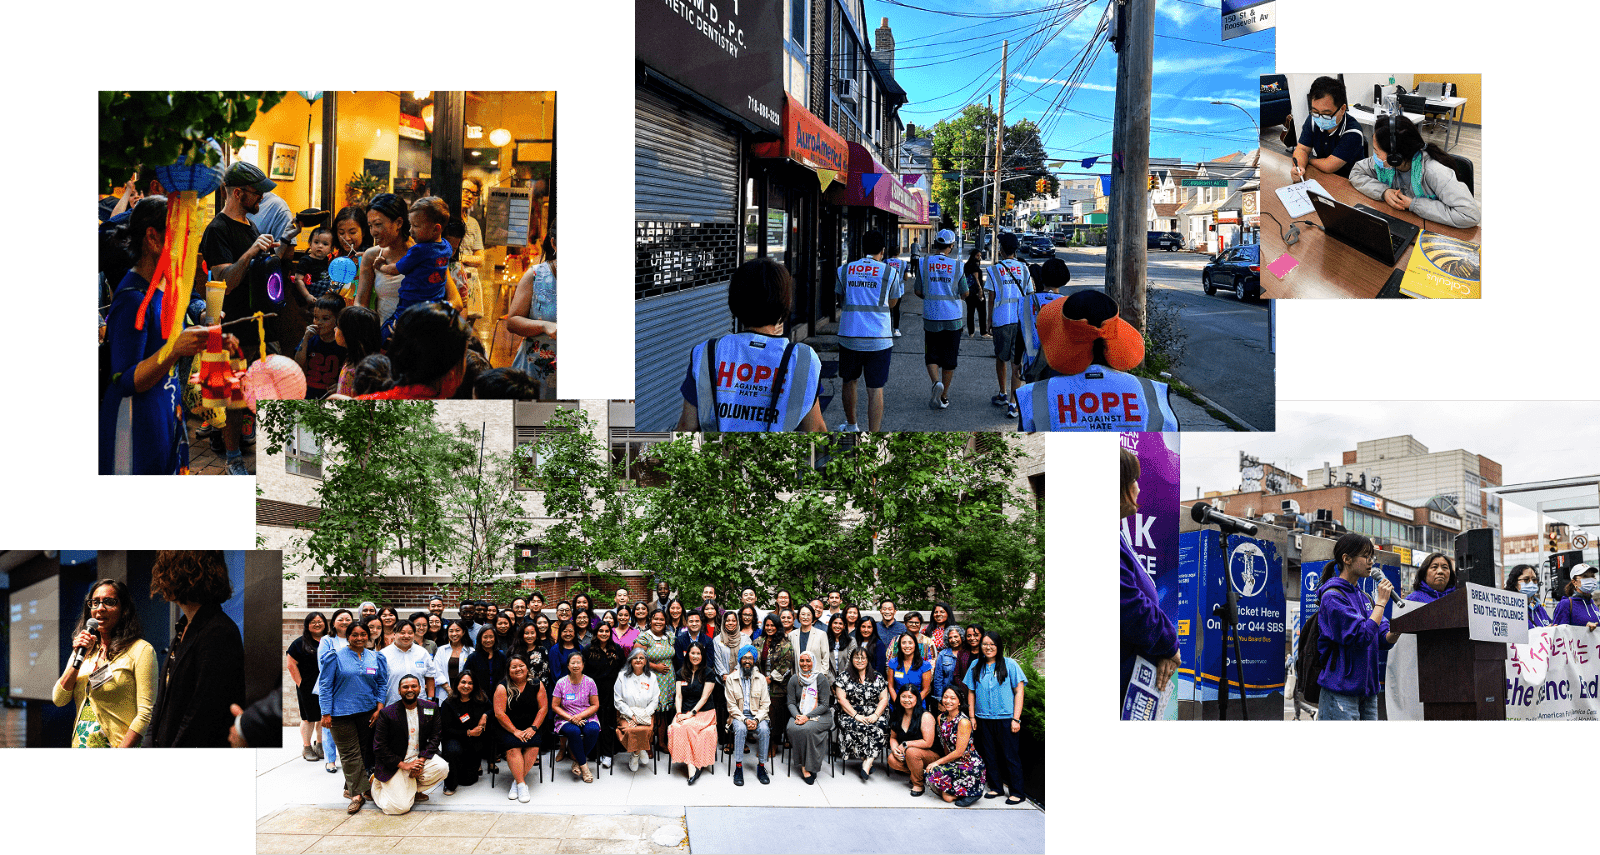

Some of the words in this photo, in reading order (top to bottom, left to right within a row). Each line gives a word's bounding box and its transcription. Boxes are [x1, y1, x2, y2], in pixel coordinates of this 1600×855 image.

[1224, 15, 1236, 24] 150
[1240, 12, 1247, 20] St
[1250, 9, 1256, 17] &
[1224, 16, 1256, 31] Roosevelt
[1260, 13, 1269, 21] Av
[697, 15, 738, 58] DENTISTRY
[848, 265, 880, 276] HOPE
[929, 263, 952, 274] HOPE
[999, 266, 1022, 276] HPE
[848, 281, 878, 289] VOLUNTEER
[1426, 273, 1470, 295] Calculus
[734, 382, 768, 392] AGAINST
[739, 390, 758, 398] HATE
[1057, 392, 1142, 424] HOPE
[1081, 415, 1122, 423] AGAINST
[1471, 589, 1490, 602] BREAK
[1490, 593, 1501, 604] THE
[1501, 596, 1525, 608] SILENCE
[1237, 605, 1259, 617] icket
[1261, 607, 1280, 618] Here
[1473, 604, 1484, 615] END
[1485, 606, 1497, 617] THE
[1496, 608, 1525, 621] VIOLENCE
[1248, 621, 1265, 632] Q44
[1267, 622, 1284, 632] SBS
[1142, 697, 1154, 721] ARCH
